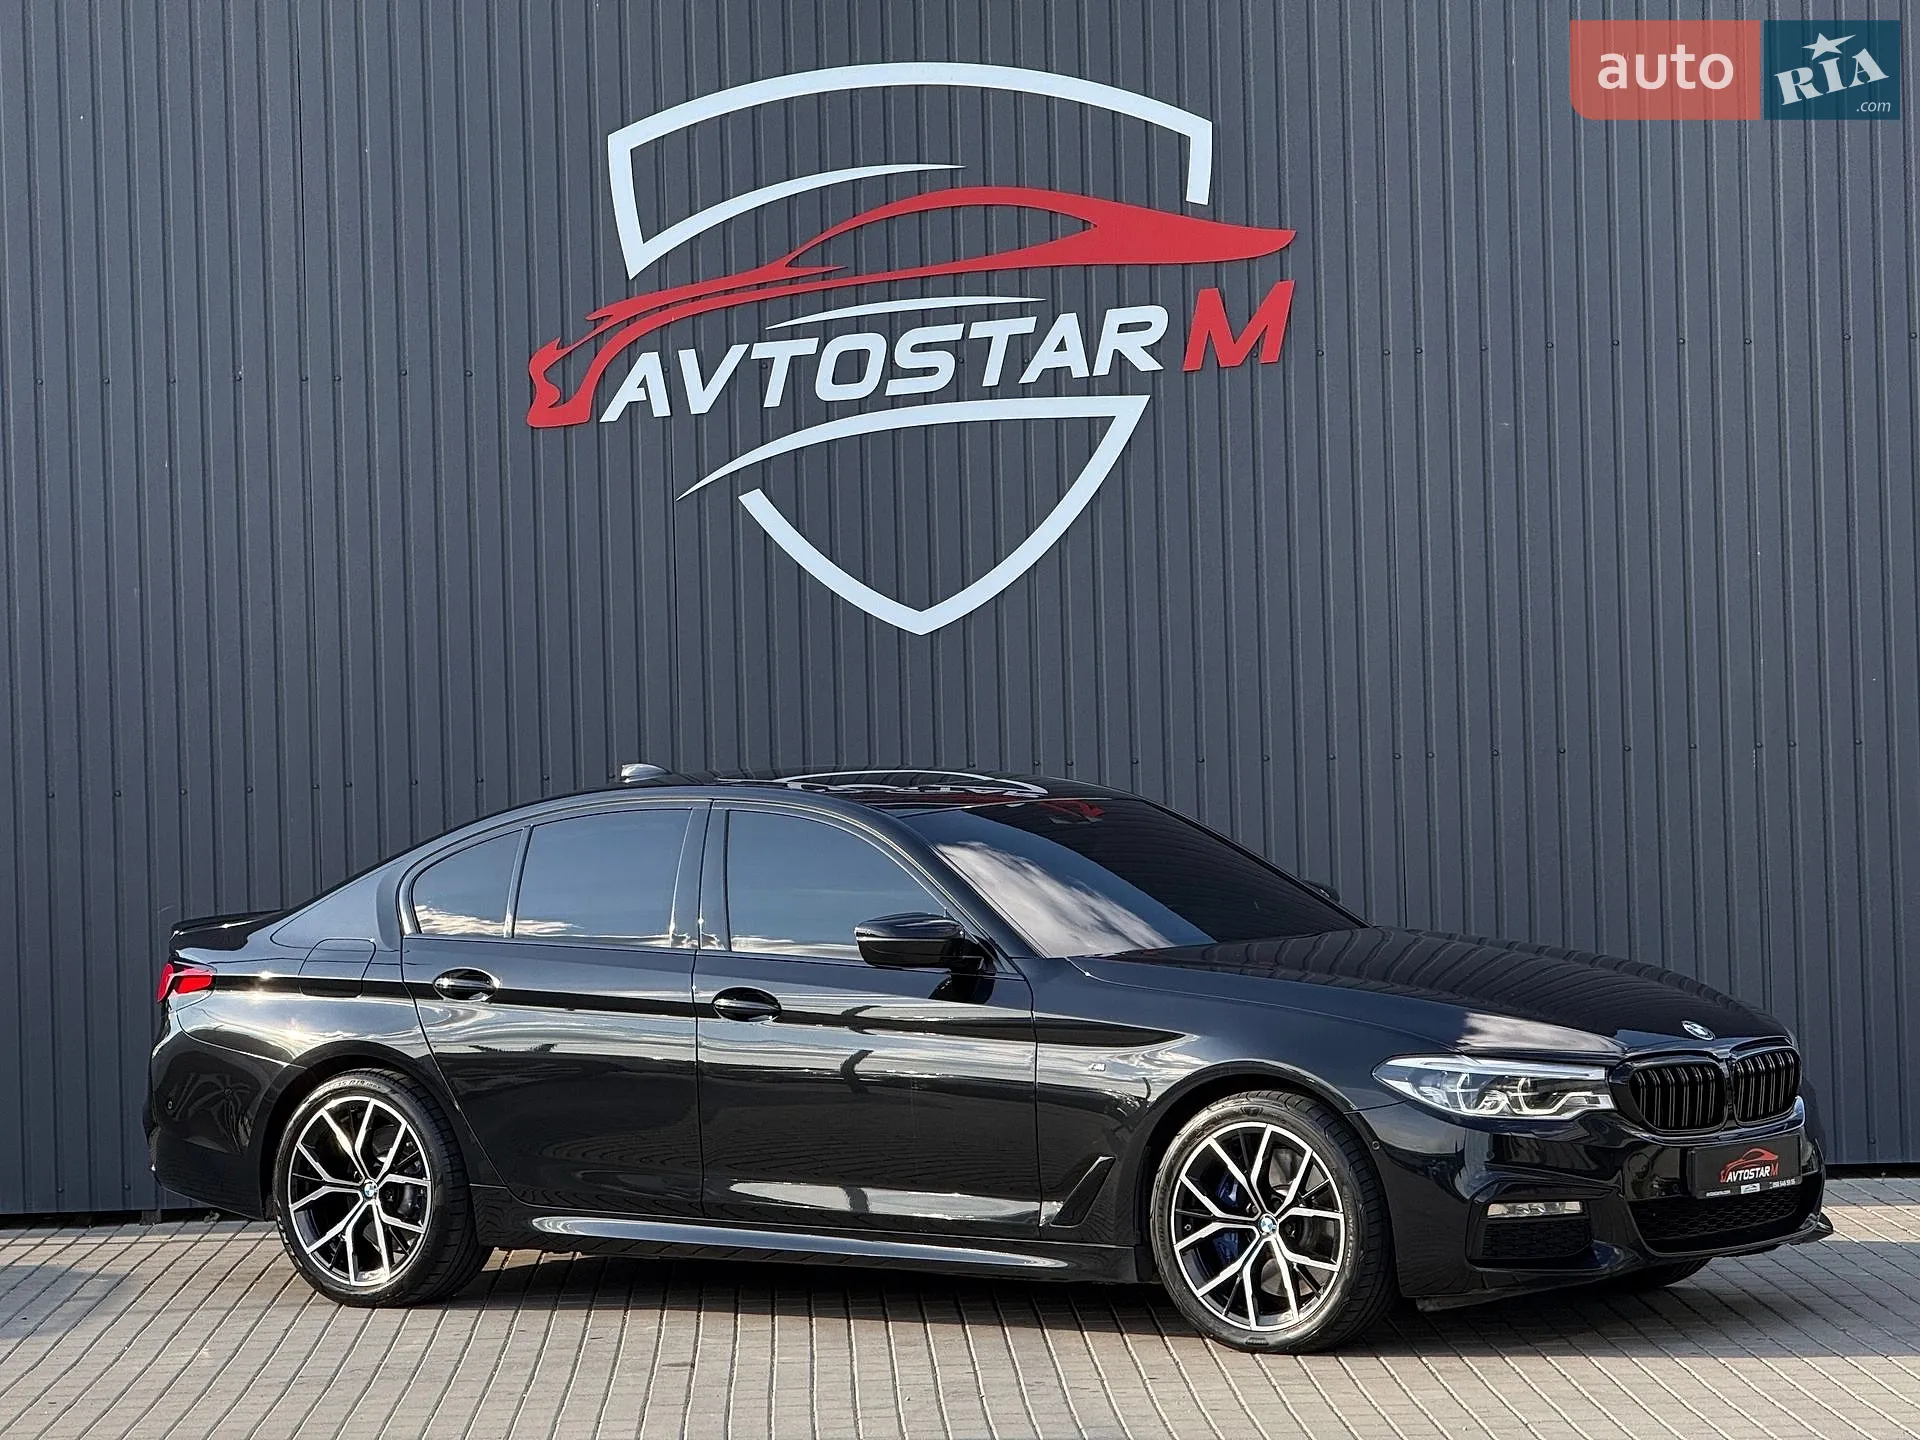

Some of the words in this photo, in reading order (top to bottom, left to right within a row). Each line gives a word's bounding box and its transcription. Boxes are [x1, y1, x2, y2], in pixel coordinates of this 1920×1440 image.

[600, 305, 1168, 422] AVTOSTAR
[1184, 281, 1295, 371] M
[1726, 1166, 1770, 1182] AVTOSTAR
